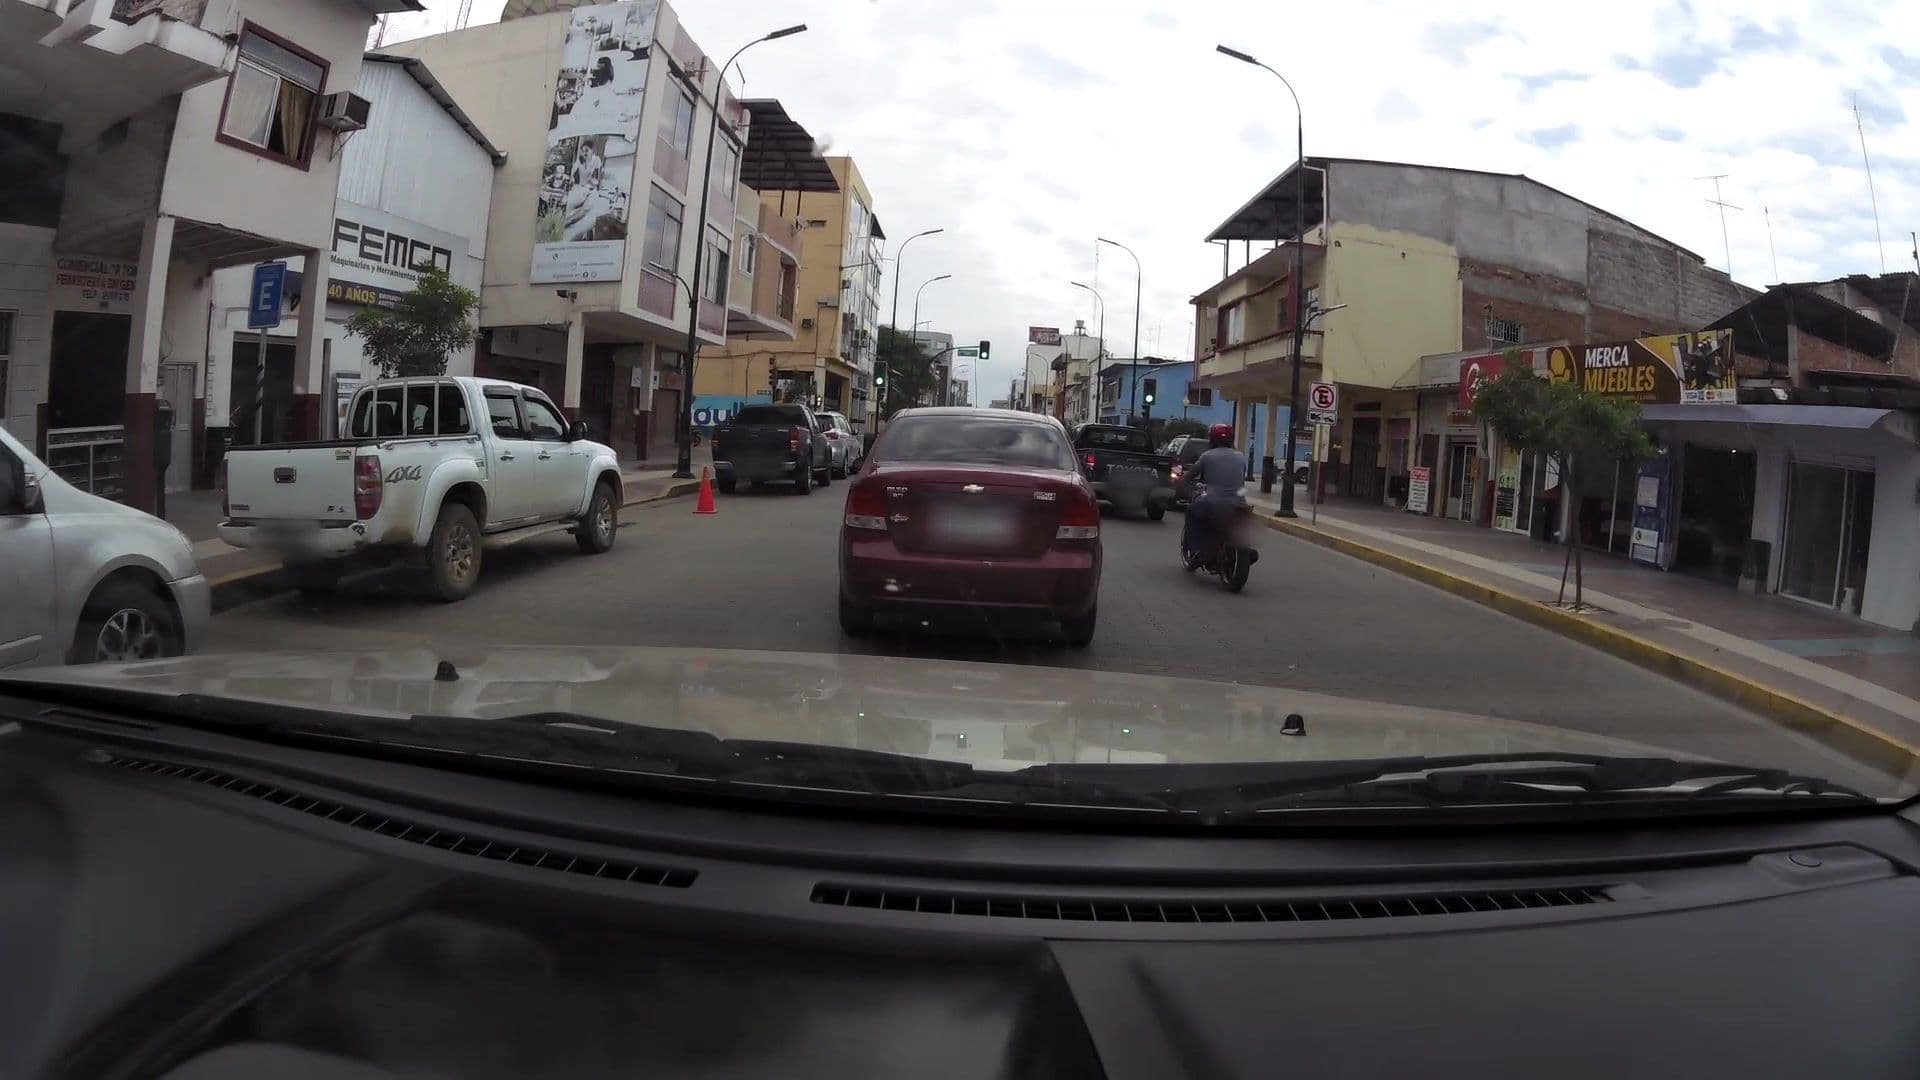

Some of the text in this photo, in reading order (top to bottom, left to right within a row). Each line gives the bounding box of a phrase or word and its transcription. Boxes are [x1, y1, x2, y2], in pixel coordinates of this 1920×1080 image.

[331, 218, 452, 280] FEMCO
[258, 281, 274, 310] E
[328, 283, 342, 299] 40
[345, 285, 376, 305] AÑOS
[1584, 345, 1629, 369] MERCA
[1584, 365, 1655, 393] MUEBLES
